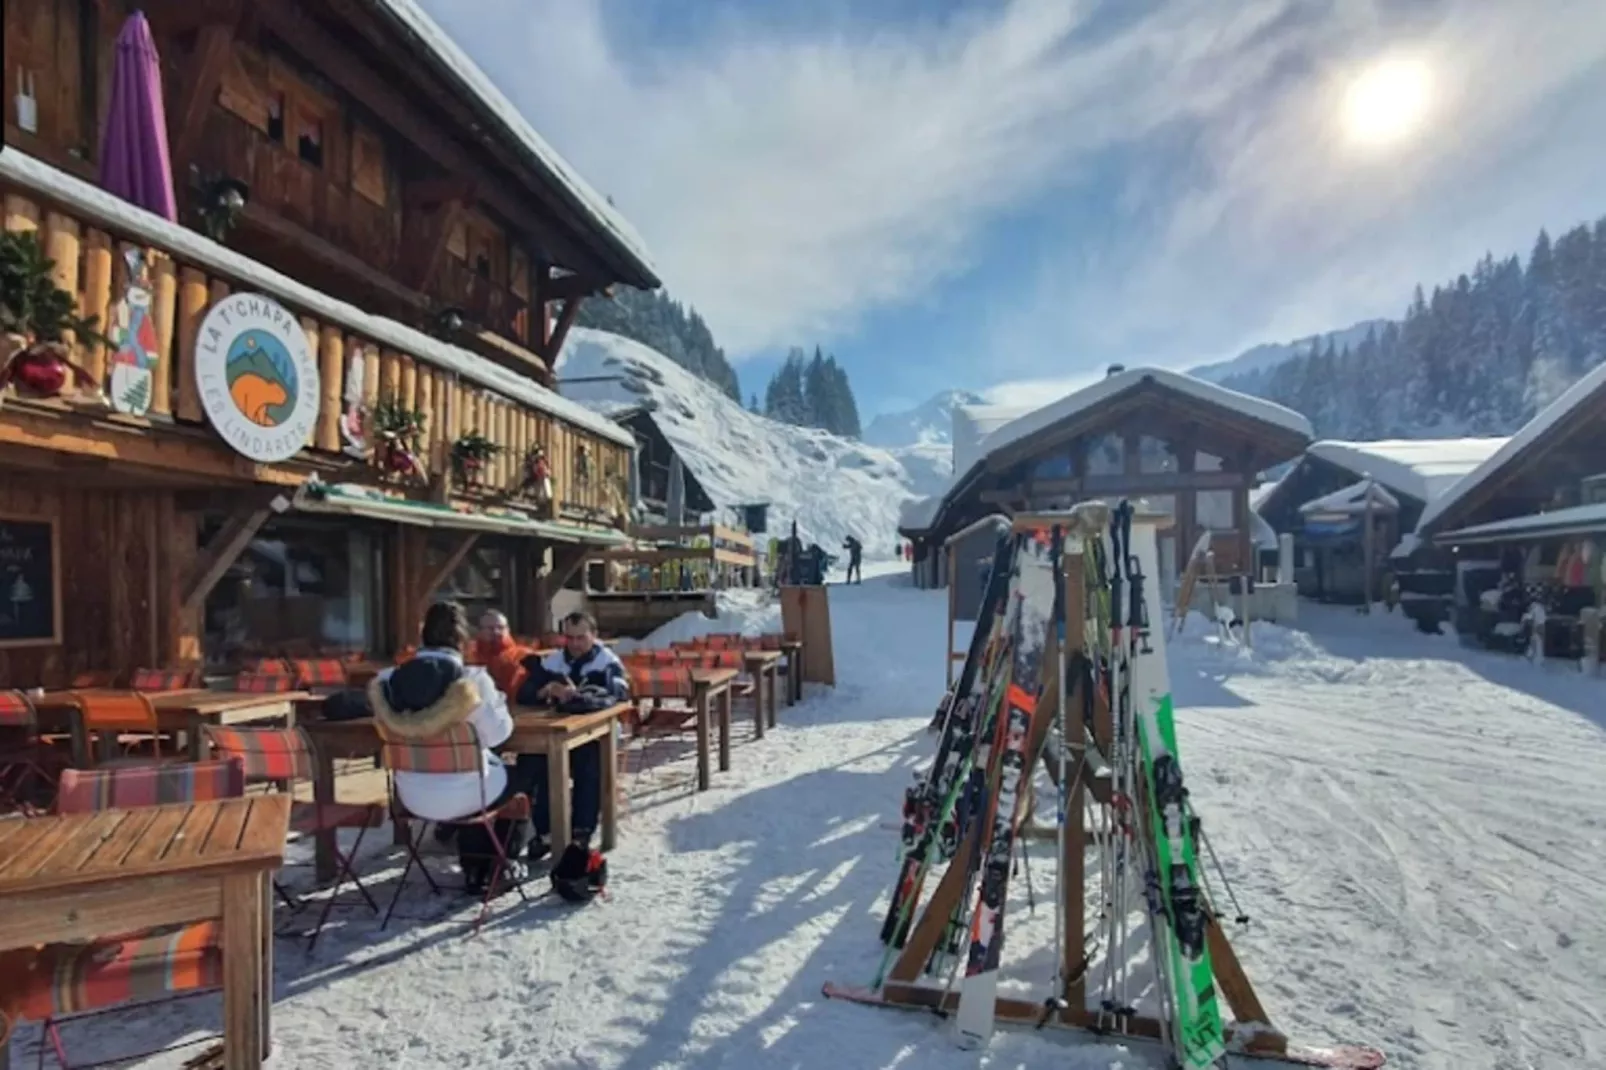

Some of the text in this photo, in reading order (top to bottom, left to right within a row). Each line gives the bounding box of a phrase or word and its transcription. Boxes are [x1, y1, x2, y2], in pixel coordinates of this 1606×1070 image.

[203, 299, 292, 354] LA T'CHAPA
[203, 373, 306, 454] LES LINDARETS
